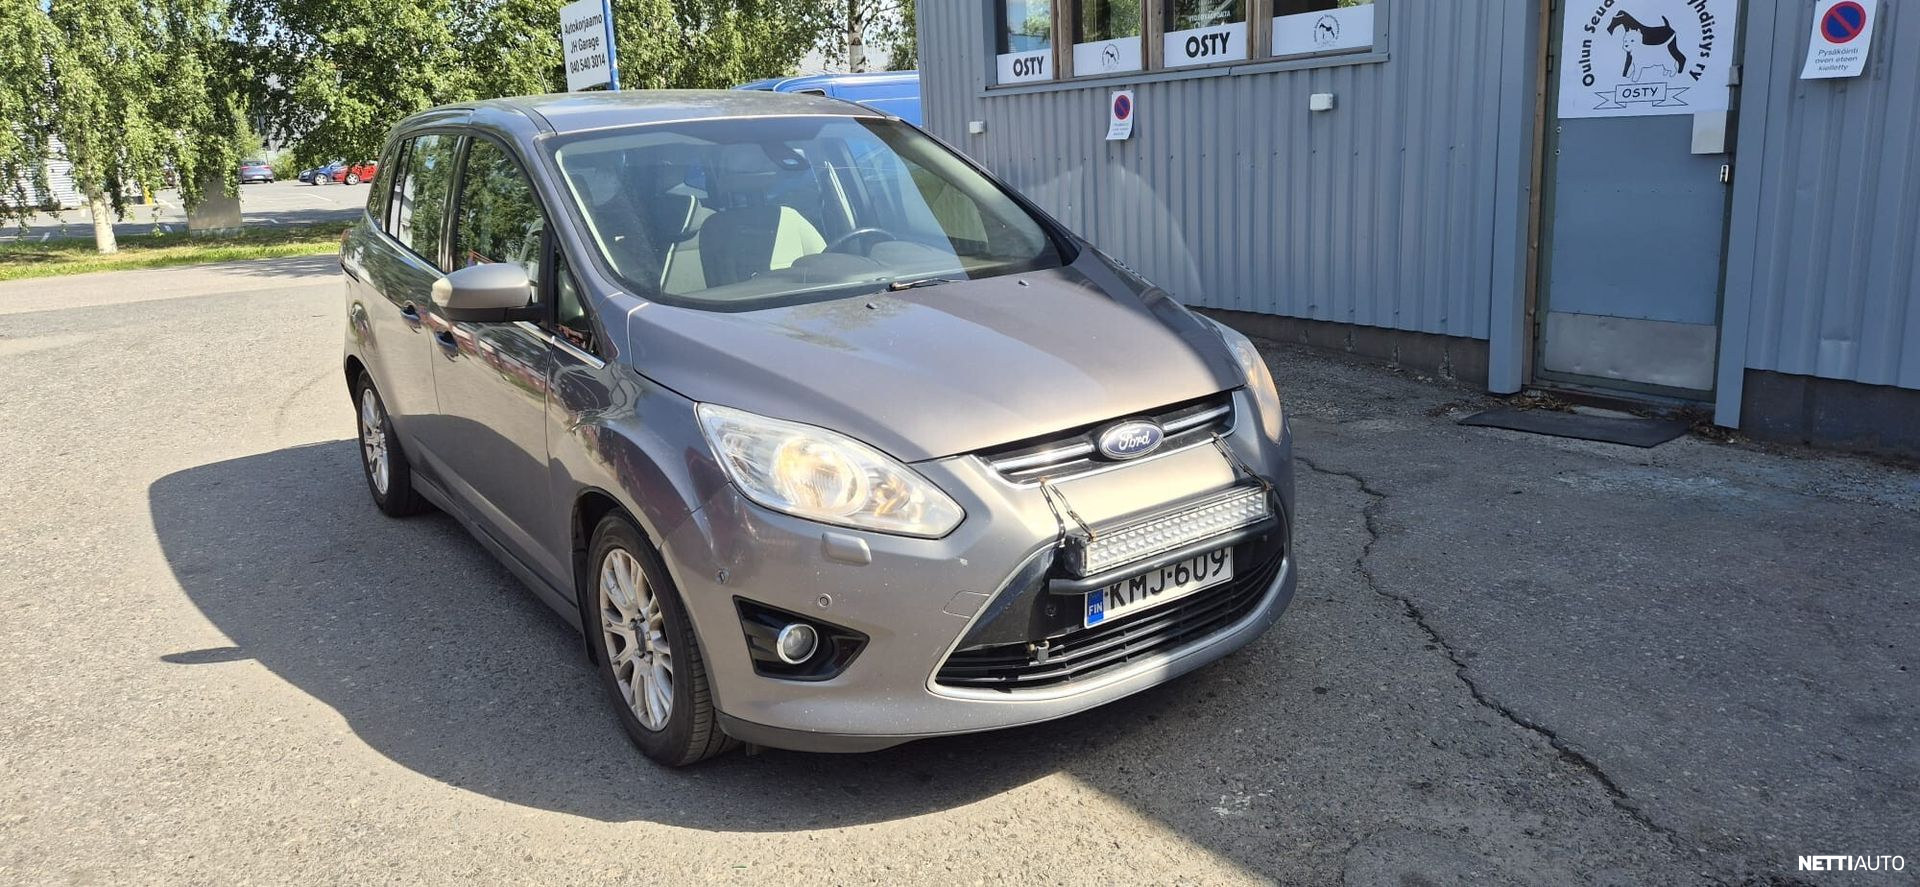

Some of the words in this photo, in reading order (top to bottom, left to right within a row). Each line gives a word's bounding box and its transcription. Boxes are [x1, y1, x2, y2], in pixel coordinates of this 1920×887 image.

[565, 14, 602, 34] Autokorjaamo
[578, 36, 600, 51] Garage
[1185, 32, 1231, 59] OSTY
[592, 53, 606, 68] 3014
[1013, 56, 1045, 77] OSTY
[1578, 40, 1595, 87] Oulun
[1689, 63, 1706, 82] ry
[1621, 86, 1659, 99] OSTY
[1118, 430, 1151, 451] Ford
[1088, 602, 1103, 616] FIN
